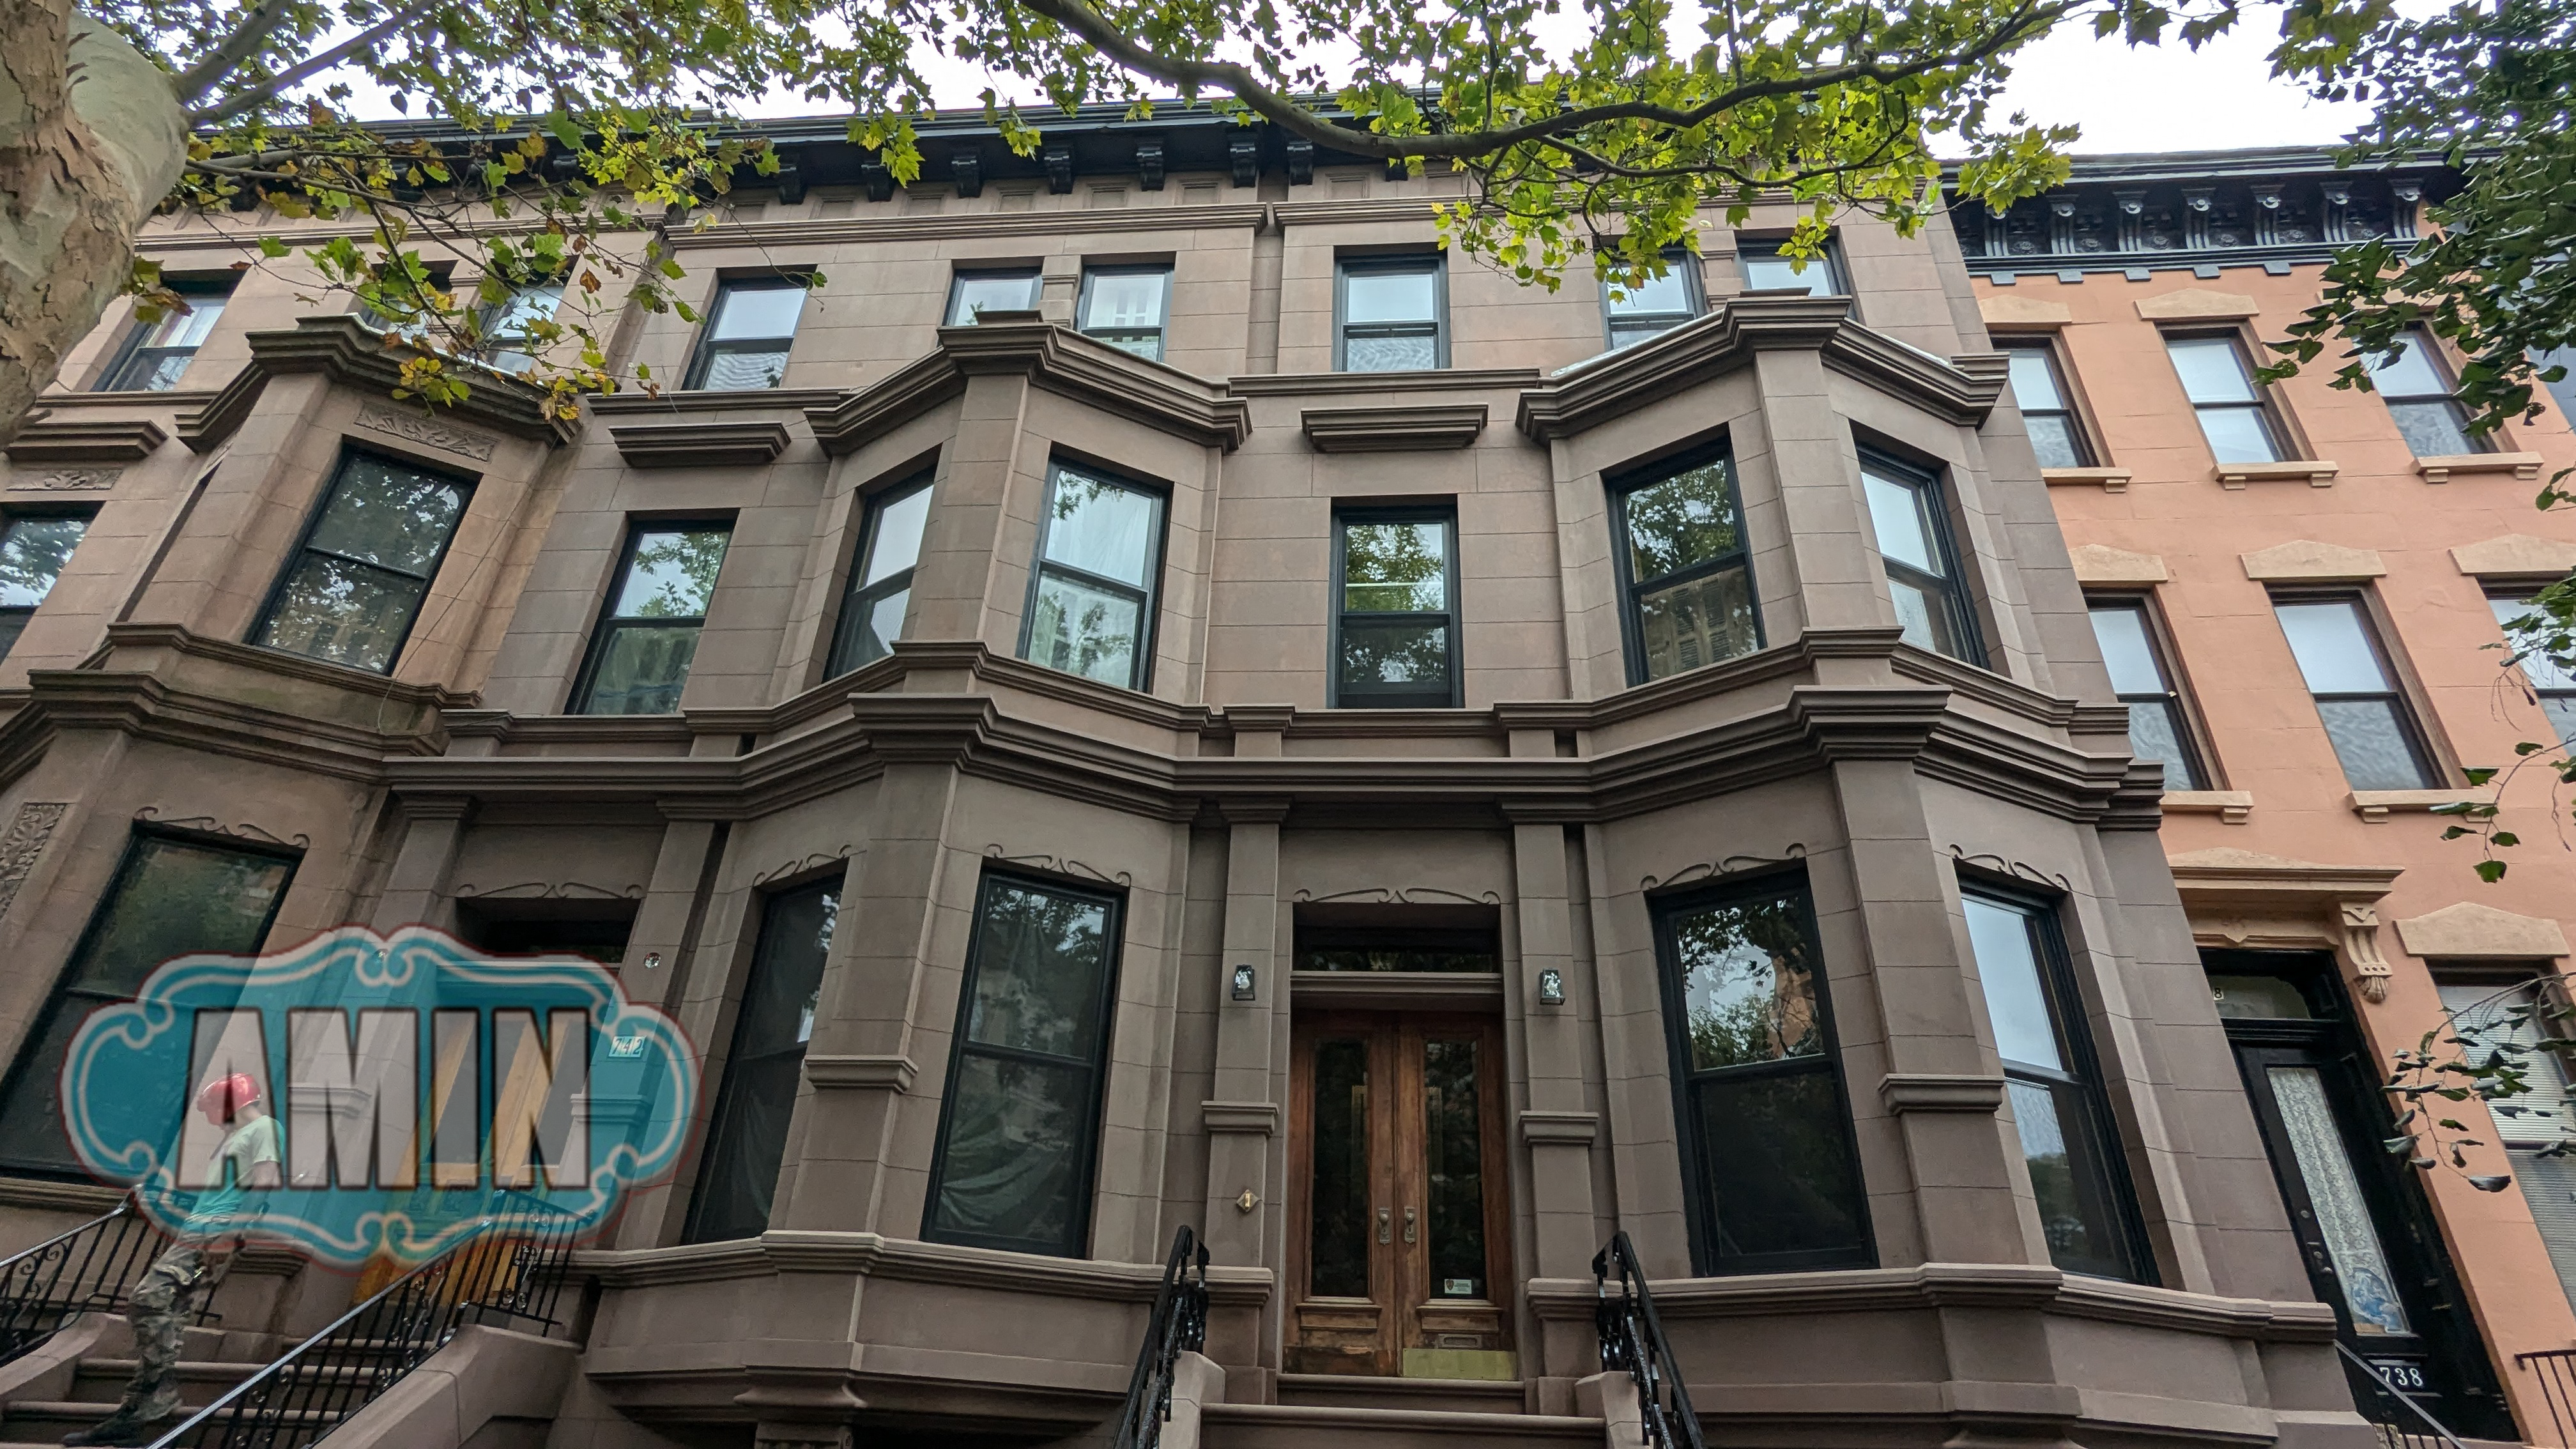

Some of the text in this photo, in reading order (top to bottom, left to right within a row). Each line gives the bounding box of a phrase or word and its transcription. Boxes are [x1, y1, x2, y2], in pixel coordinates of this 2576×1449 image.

[2214, 987, 2223, 999] 8
[611, 1038, 643, 1055] 742
[2379, 1367, 2423, 1386] 738
